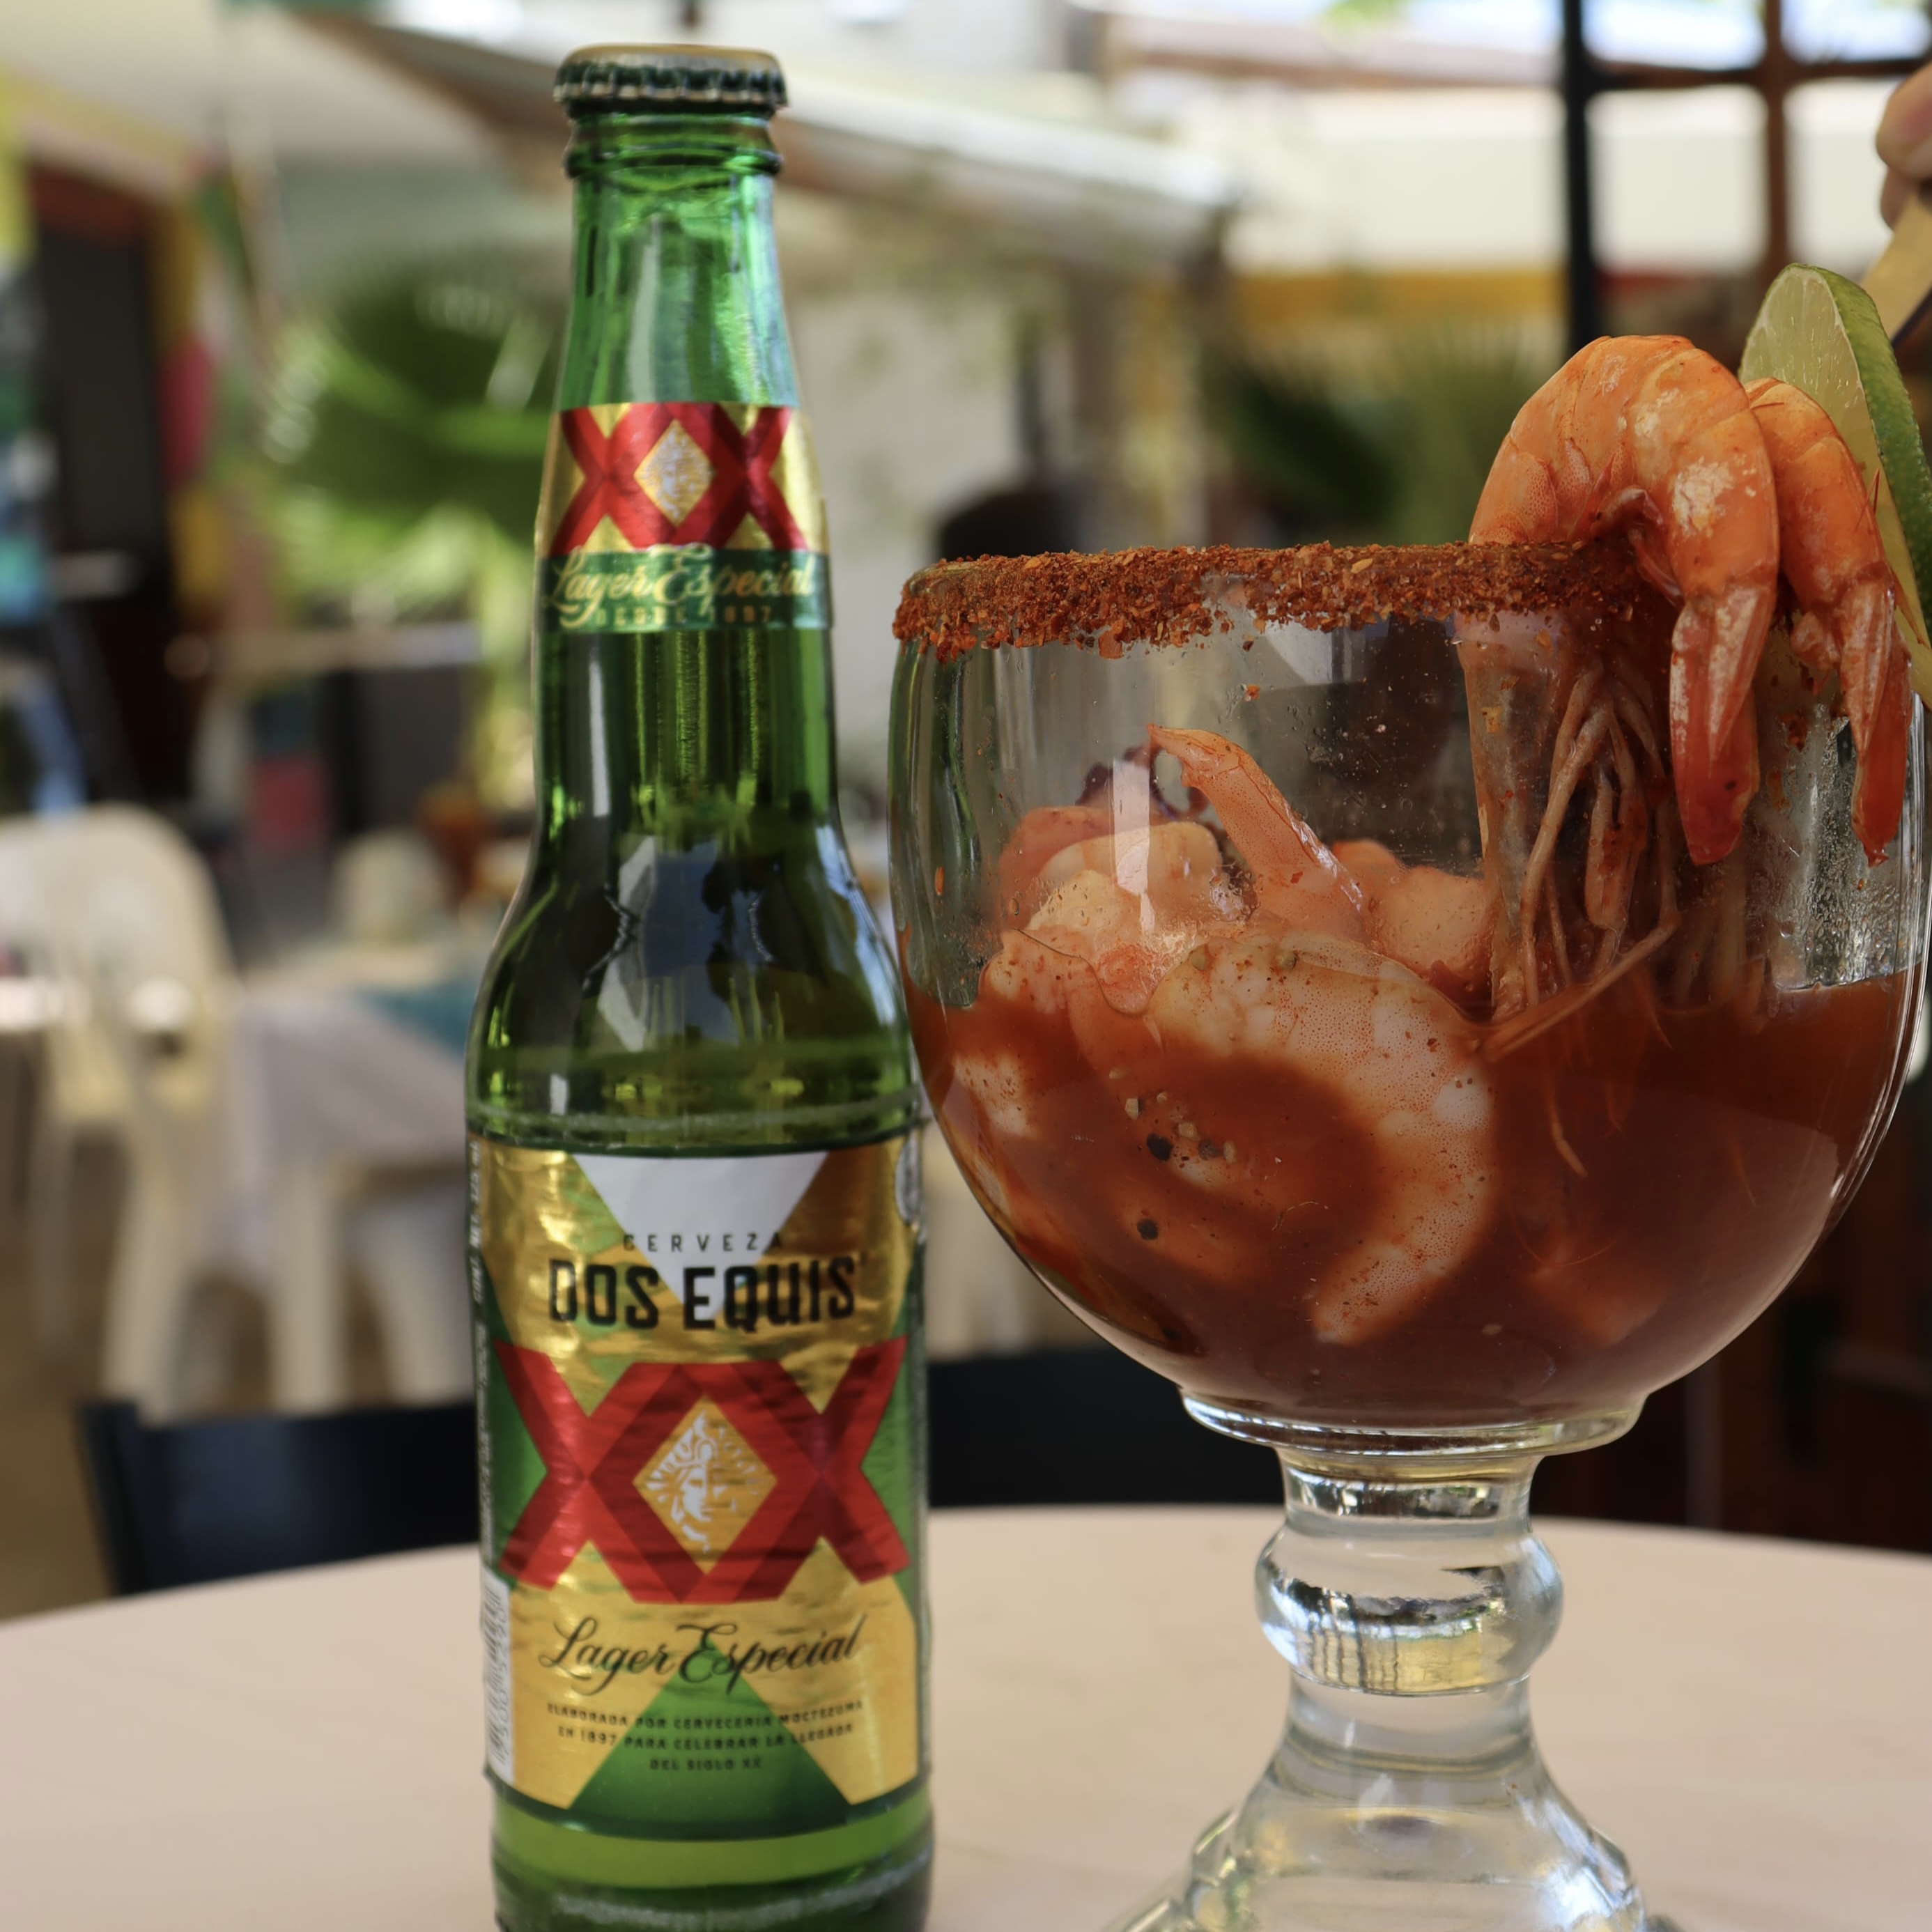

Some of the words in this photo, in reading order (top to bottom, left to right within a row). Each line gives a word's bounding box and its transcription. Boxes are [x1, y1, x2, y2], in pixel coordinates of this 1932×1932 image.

[544, 546, 654, 627] Lager
[647, 543, 817, 616] Especial
[622, 1231, 783, 1253] CERVEZA
[548, 1258, 660, 1329] DOS
[682, 1256, 856, 1332] EQUIS
[538, 1616, 677, 1696] Lager
[675, 1614, 867, 1695] Especial
[546, 1702, 628, 1727] ELABORADA
[635, 1717, 667, 1729] POR
[779, 1700, 863, 1723] MOCTEZUMA
[558, 1726, 573, 1739] EN
[580, 1730, 617, 1747] 1897
[624, 1736, 667, 1749] PARA
[674, 1737, 759, 1750] CELEBRAR
[766, 1733, 784, 1747] LA
[649, 1759, 680, 1771] DEL
[687, 1758, 734, 1771] SIGLO
[741, 1757, 762, 1770] XX
